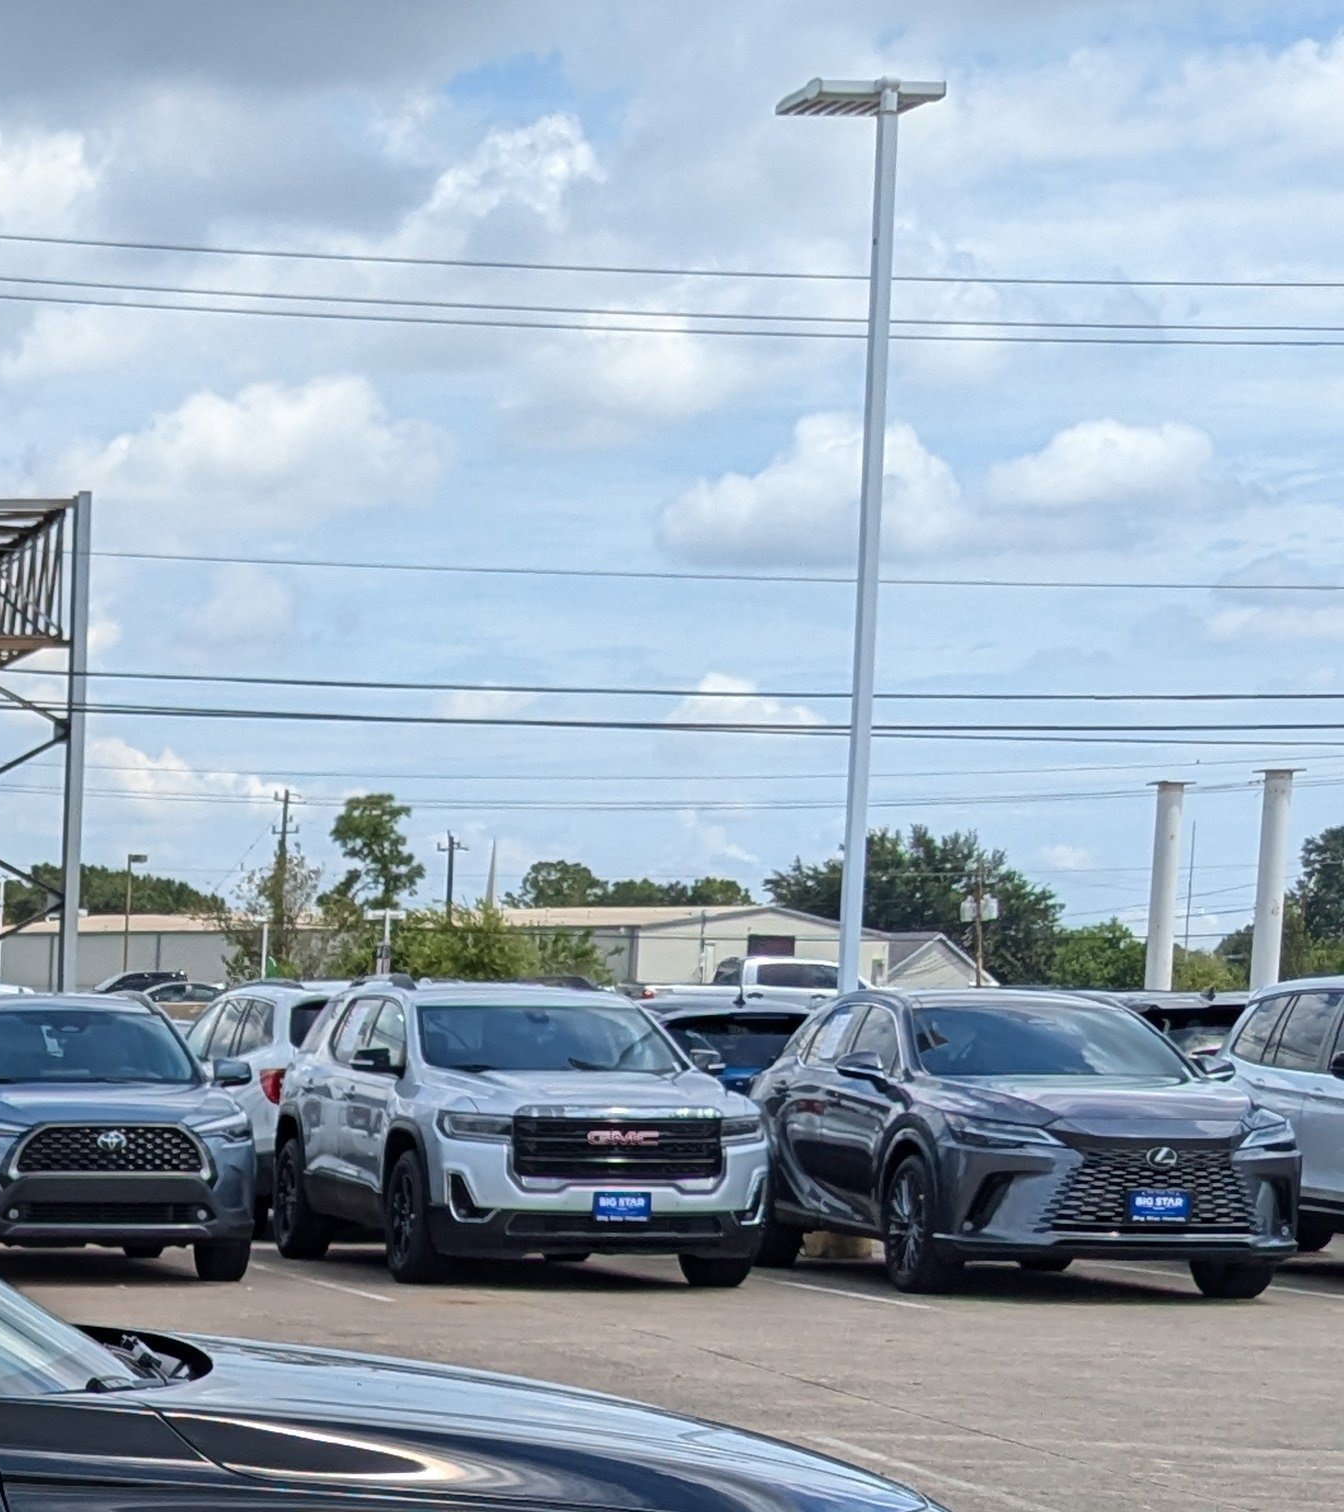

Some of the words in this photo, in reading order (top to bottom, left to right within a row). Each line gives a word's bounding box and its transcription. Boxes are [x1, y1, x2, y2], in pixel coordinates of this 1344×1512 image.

[587, 1130, 660, 1146] GMC
[599, 1196, 617, 1207] BIG
[618, 1196, 646, 1207] STAR
[1135, 1196, 1154, 1207] BIG
[1155, 1196, 1183, 1208] STAR
